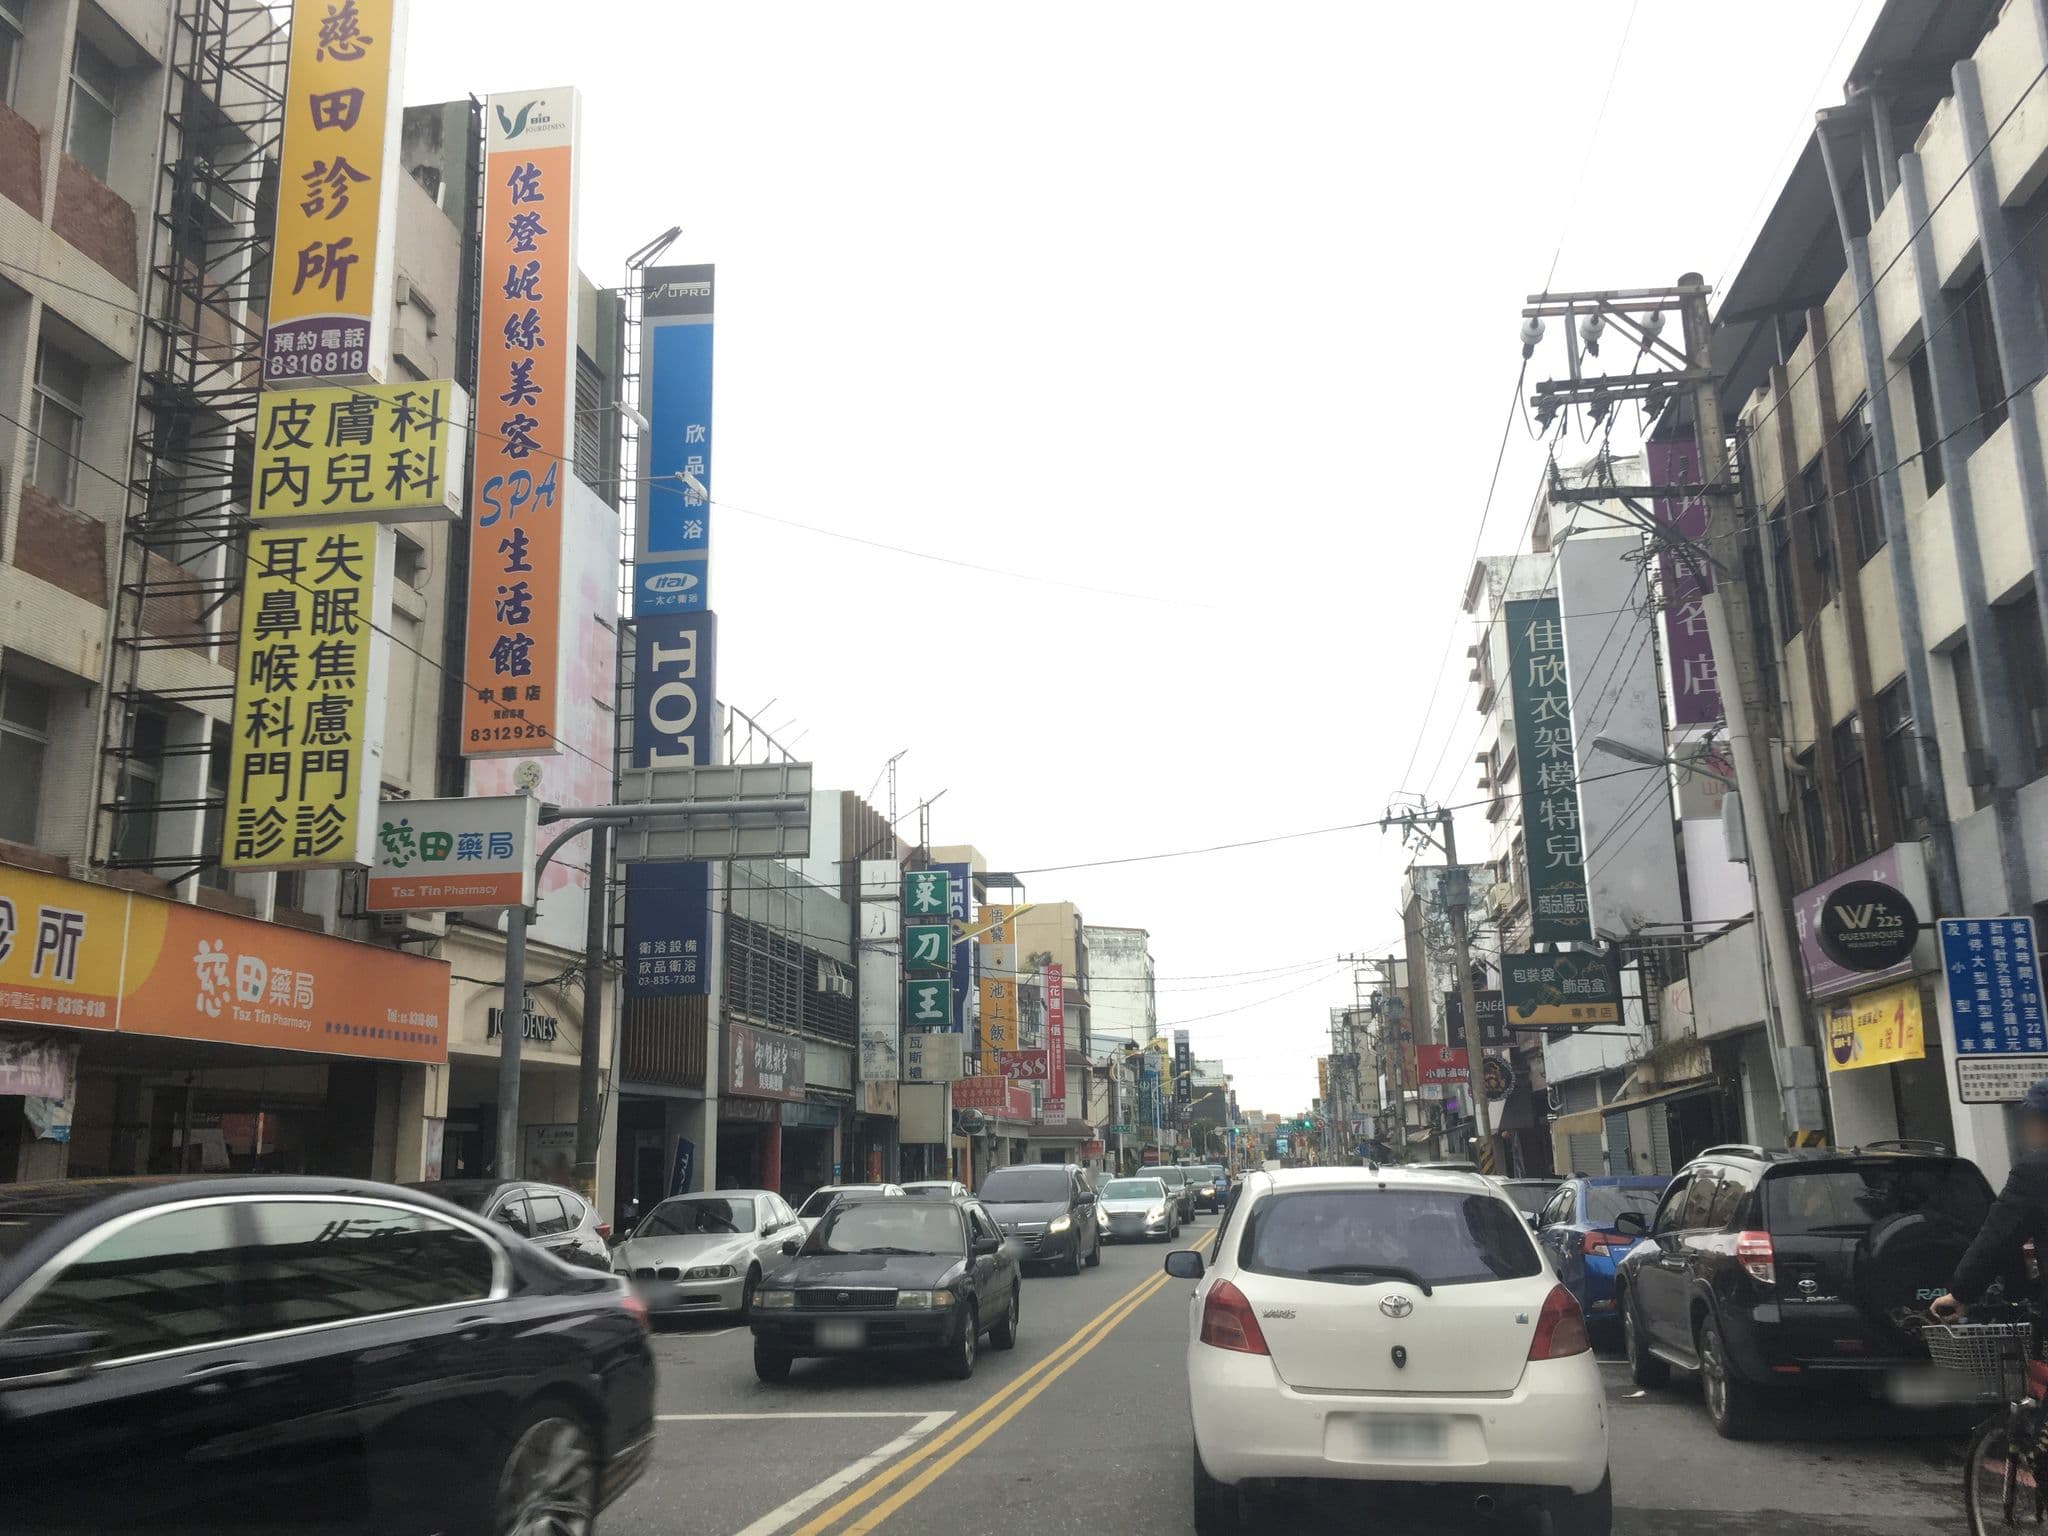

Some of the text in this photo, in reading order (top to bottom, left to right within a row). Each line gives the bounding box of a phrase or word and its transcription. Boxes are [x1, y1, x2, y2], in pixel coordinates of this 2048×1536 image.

[293, 2, 373, 302] 慈田診所
[274, 328, 365, 354] 預約電話
[270, 350, 363, 376] 8316818
[262, 389, 442, 450] 皮膚科
[258, 446, 440, 510] 內兒科
[234, 538, 308, 860] 耳鼻喉科門診
[292, 534, 363, 857] 失眠焦慮門診
[471, 725, 547, 742] 8312926
[1525, 619, 1583, 869] 佳欣衣架模特兒
[378, 818, 513, 868] 慈田藥局
[391, 884, 498, 897] Tsz Tin Pharmacy
[1538, 893, 1589, 914] 商品展示
[1876, 916, 1904, 928] 225
[1838, 930, 1905, 942] GUESTHOUSE
[193, 939, 314, 1018] 慈田藥局
[639, 959, 697, 974] 欣品衛浴
[1512, 968, 1556, 983] 包裝袋
[638, 975, 696, 986] 03-835-7308
[1562, 979, 1606, 993] 飾品盒
[232, 1006, 312, 1032] Tsz Tin Pharmacy
